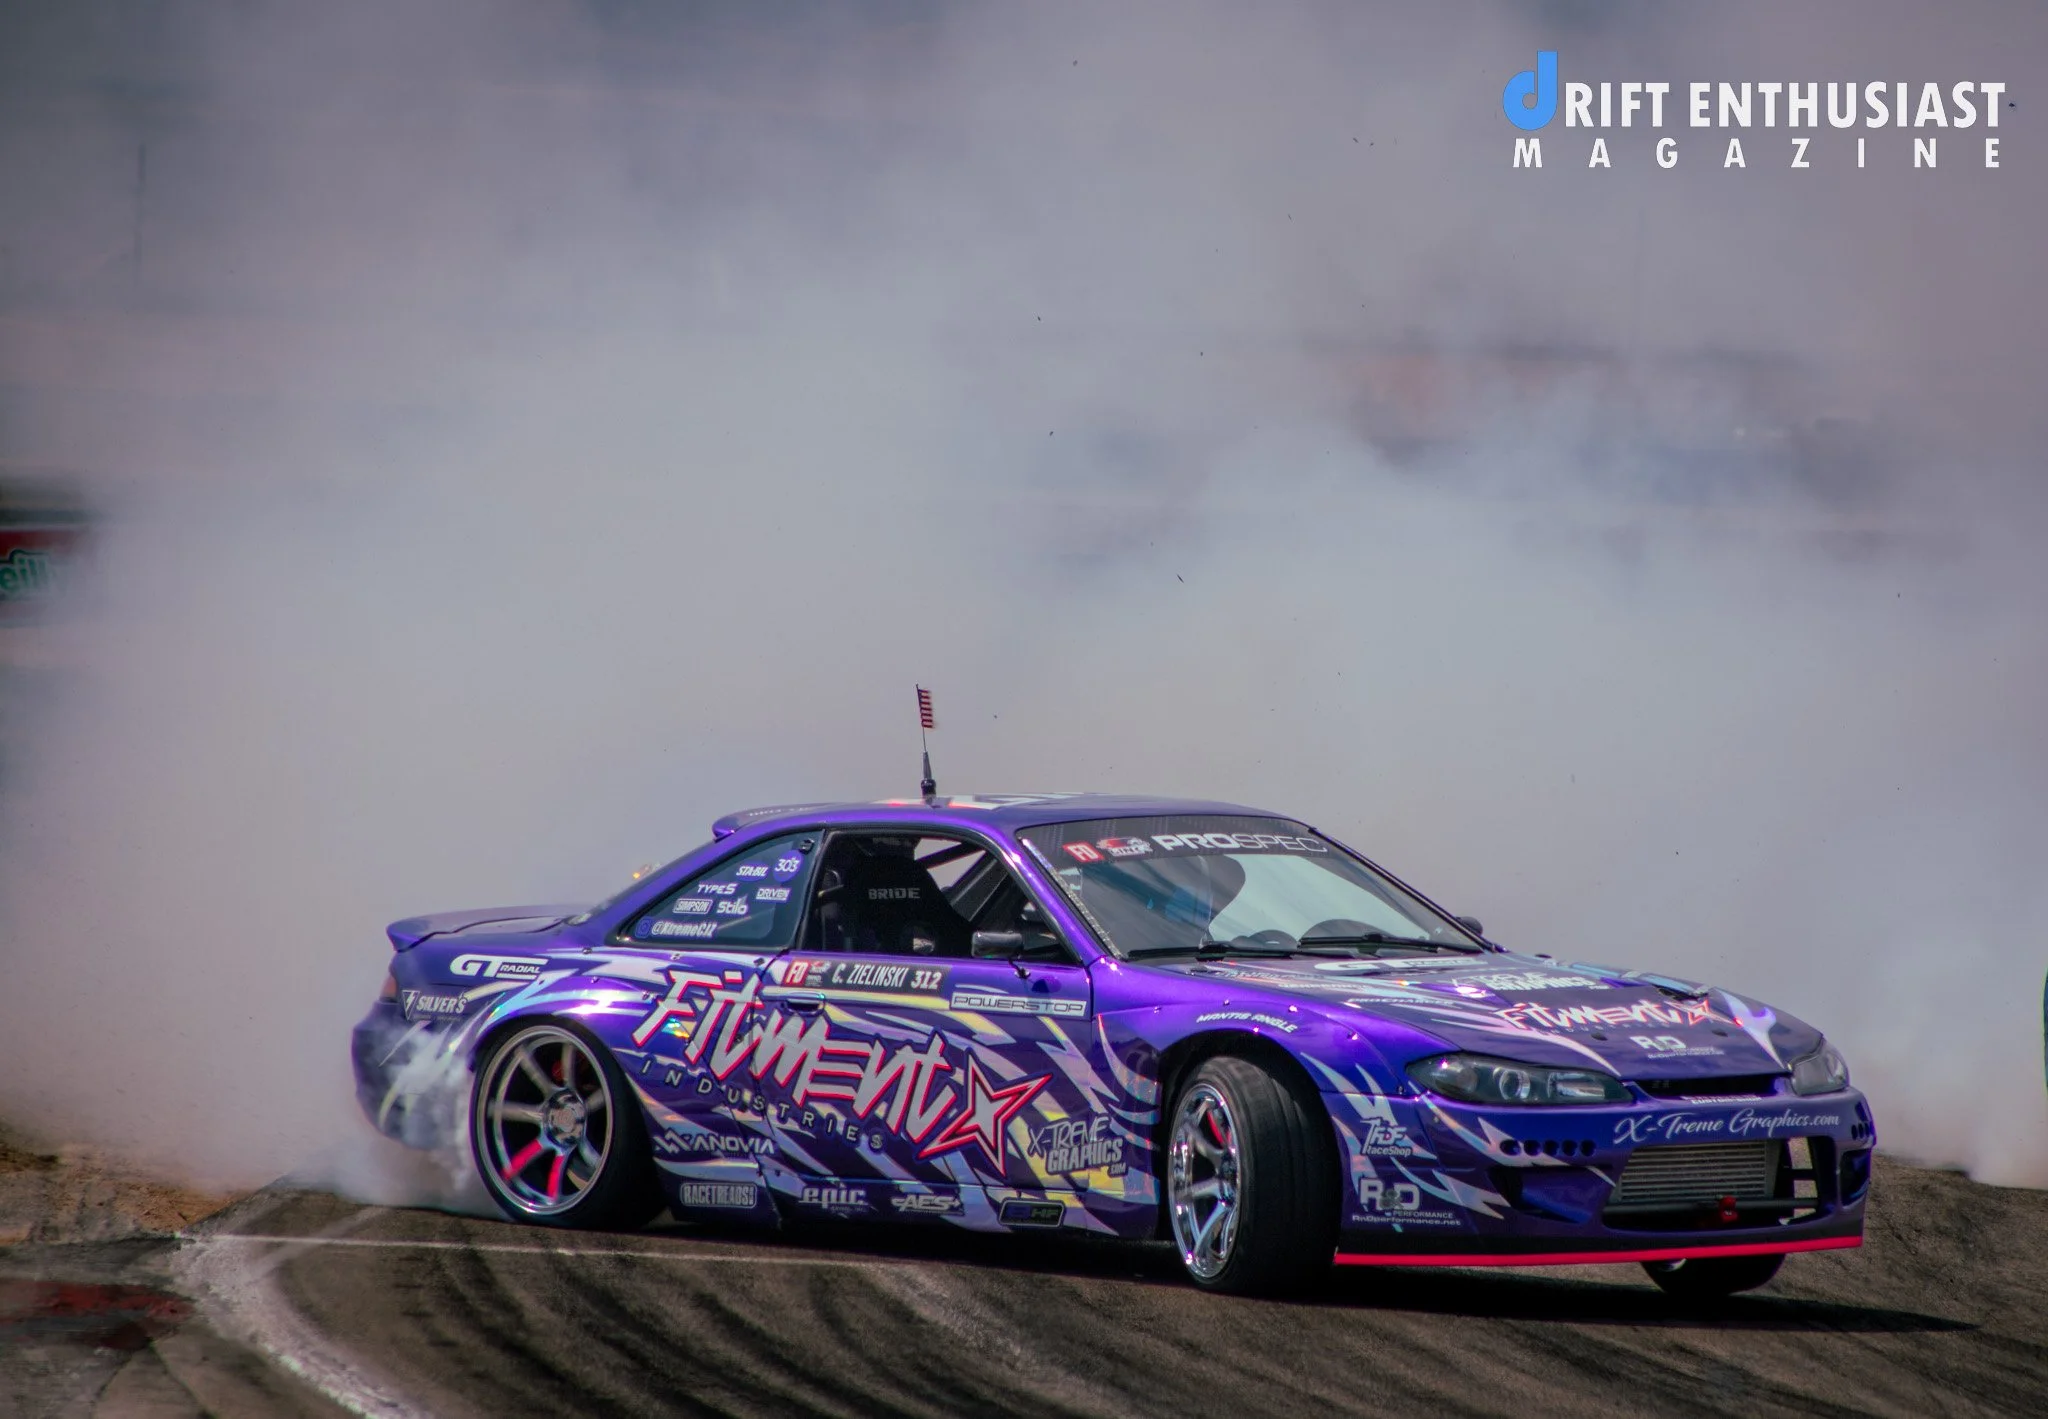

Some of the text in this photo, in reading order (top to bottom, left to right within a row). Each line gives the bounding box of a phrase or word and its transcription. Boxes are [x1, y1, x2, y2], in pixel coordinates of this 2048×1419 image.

[868, 887, 920, 900] BRIDE
[500, 964, 541, 974] RADIAL
[846, 964, 908, 988] ZIELINSKI
[911, 969, 942, 990] 312
[953, 995, 1084, 1014] POWERSTOP
[1197, 1012, 1297, 1033] MANTIS ANGLE
[641, 1059, 885, 1150] INDUSTRIES
[1729, 1108, 1840, 1137] Graphics.com
[1048, 1138, 1123, 1172] GRAPHICS
[1392, 1211, 1454, 1219] PERFORMANCE
